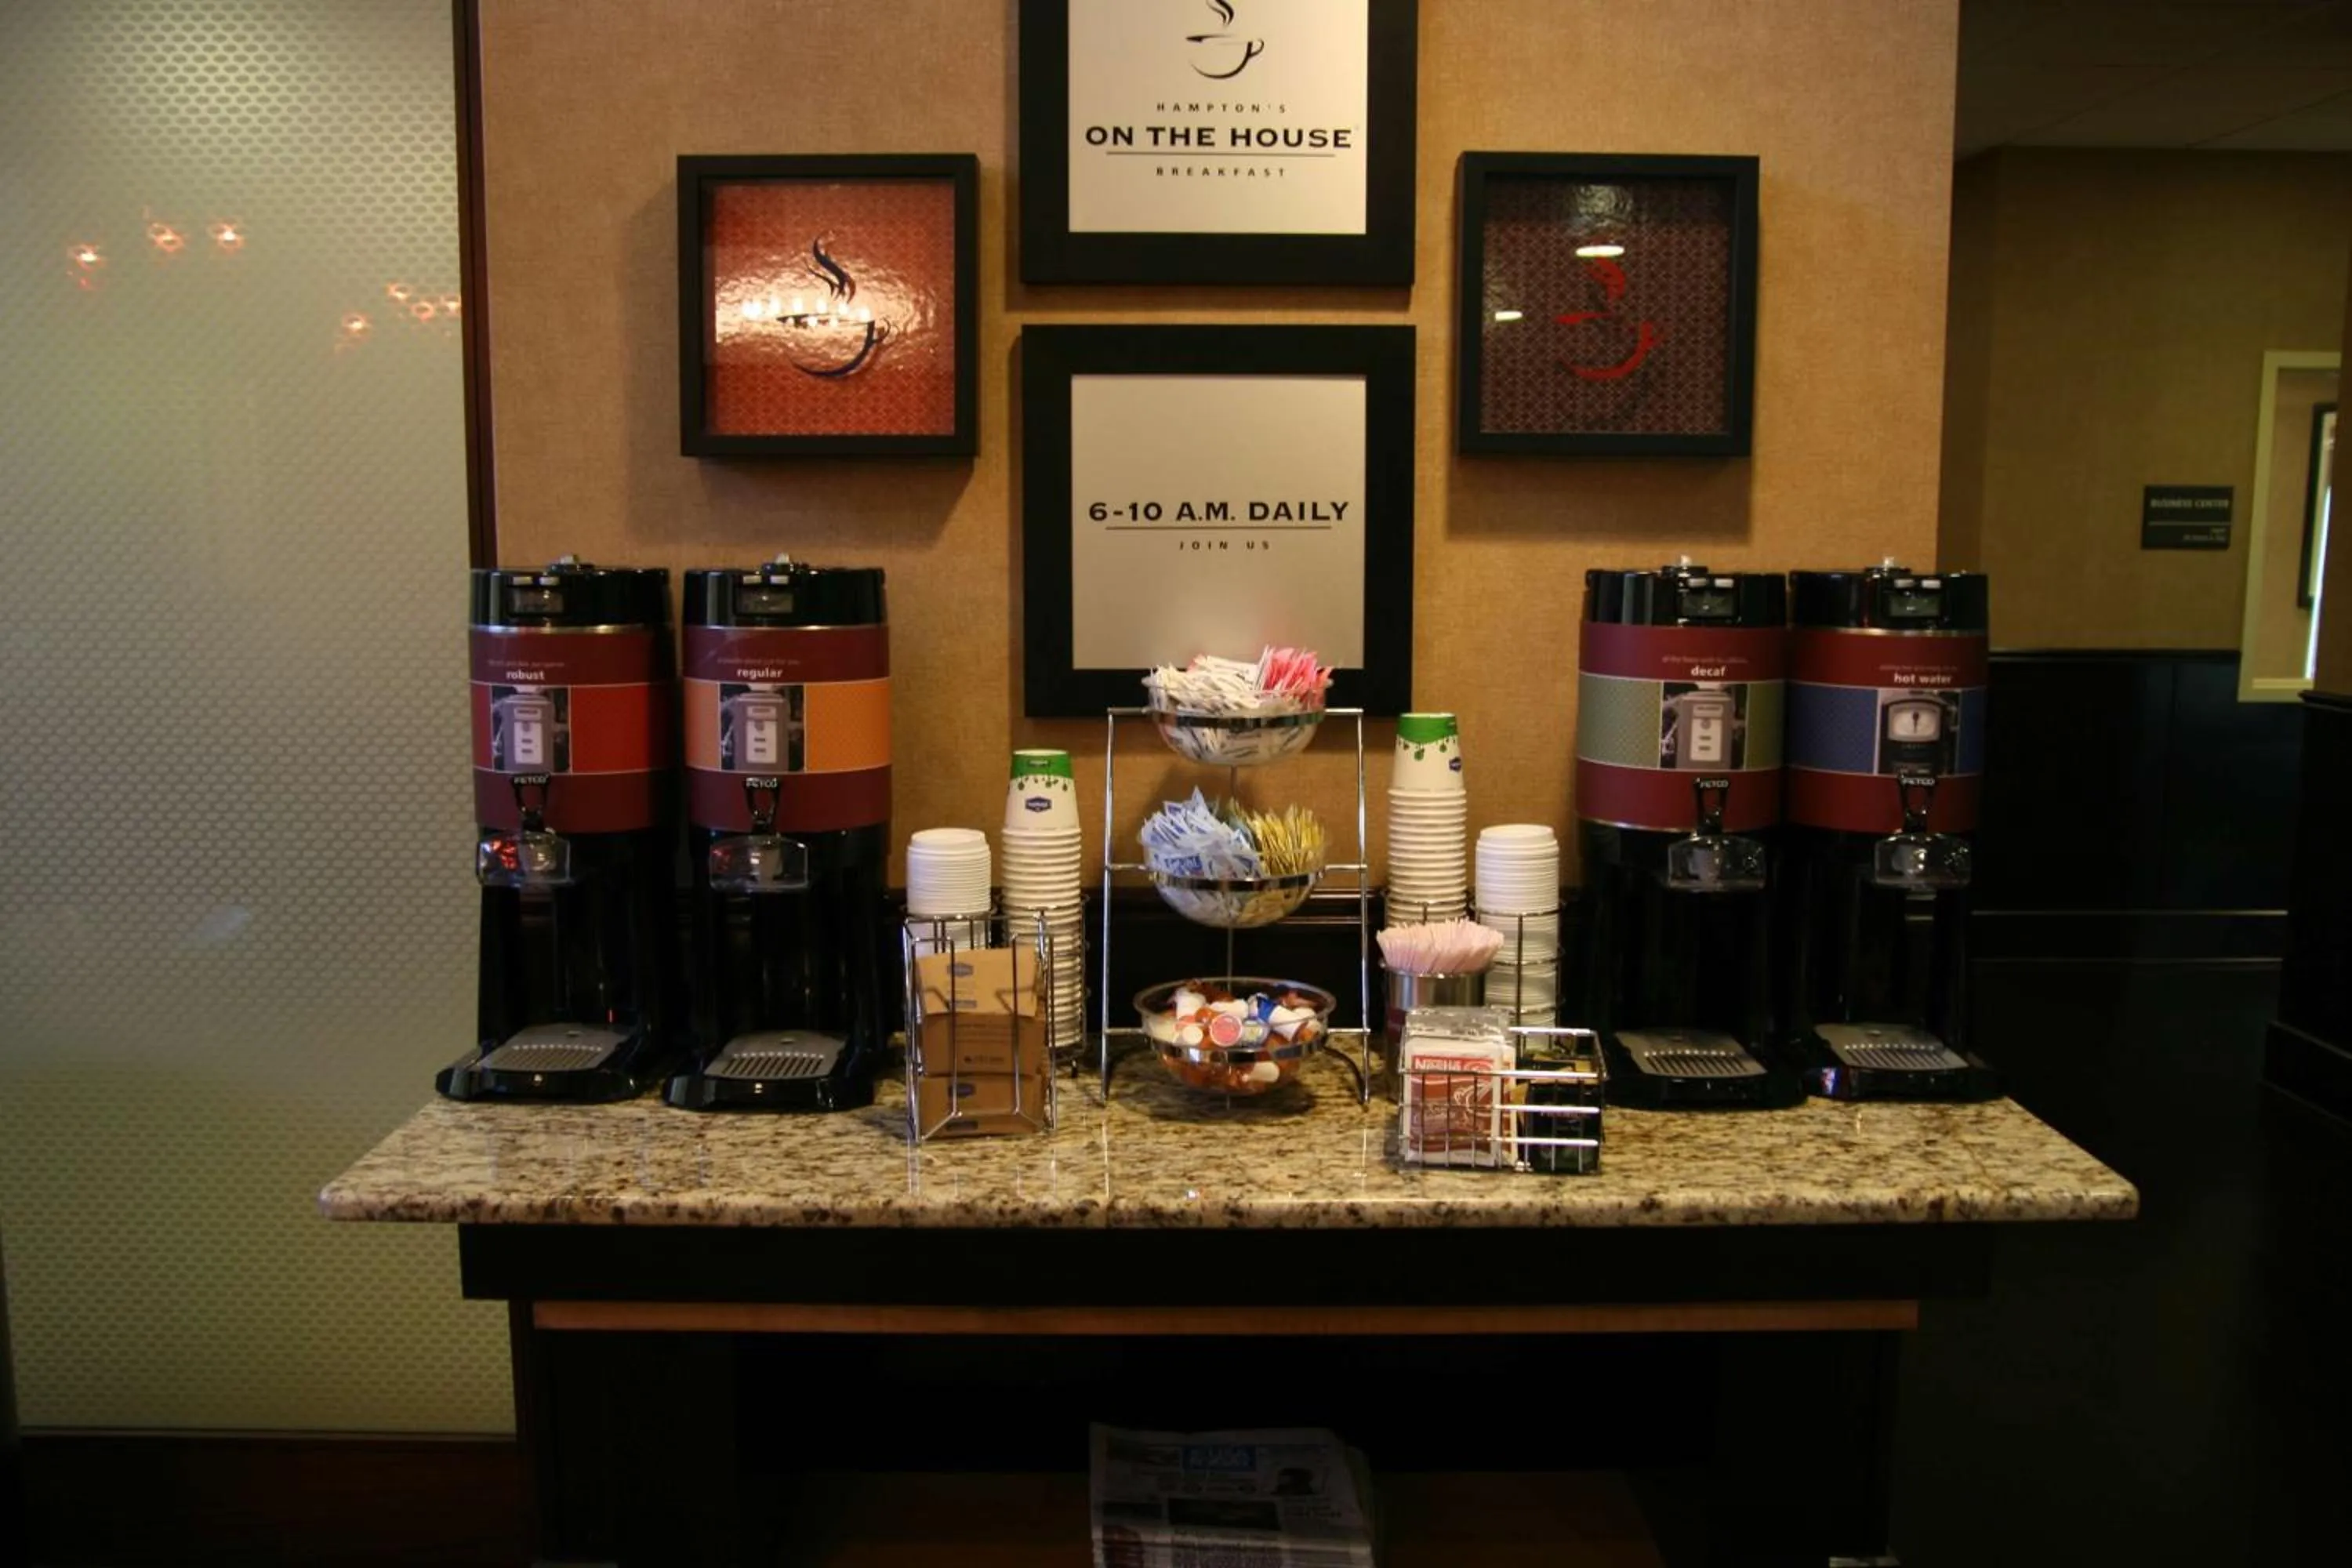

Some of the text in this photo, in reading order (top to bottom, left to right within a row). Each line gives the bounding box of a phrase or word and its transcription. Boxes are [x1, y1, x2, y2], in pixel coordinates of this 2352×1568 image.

[1156, 103, 1286, 114] HAMPTON'S
[1085, 126, 1352, 148] ON THE HOUSE
[1156, 167, 1286, 177] BREAKFAST
[1088, 502, 1349, 521] 6-10 A.M. DAILY
[1179, 540, 1270, 550] JOIN US
[506, 669, 545, 681] robust
[736, 667, 783, 680] regular
[1690, 665, 1726, 677] decaf
[1893, 671, 1952, 684] hot water
